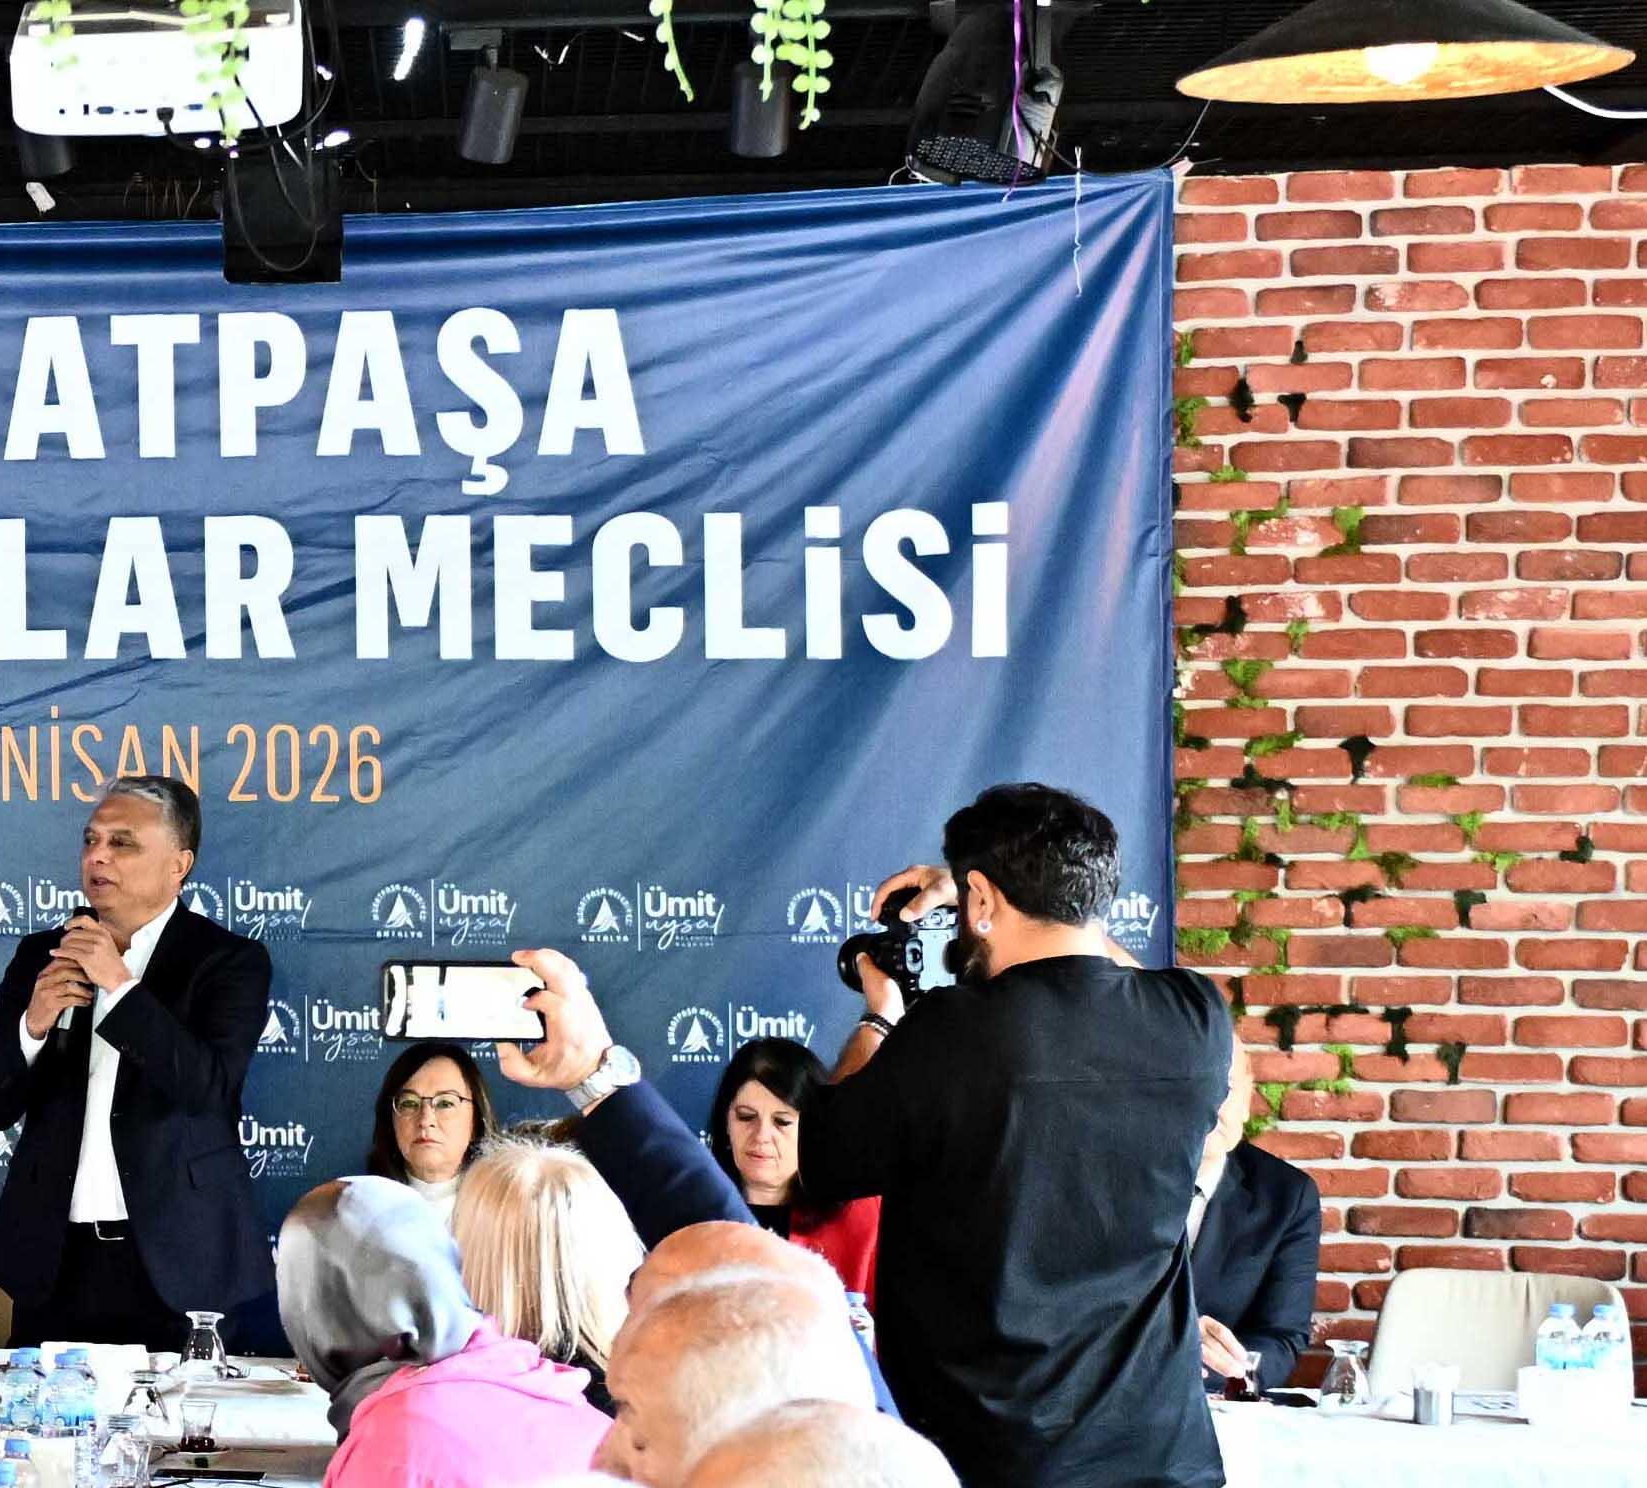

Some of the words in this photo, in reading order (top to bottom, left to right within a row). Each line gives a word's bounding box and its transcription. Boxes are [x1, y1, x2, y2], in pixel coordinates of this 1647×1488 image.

[1, 705, 200, 801] NİSAN
[226, 723, 383, 803] 2026
[234, 880, 304, 911] Ümit
[438, 883, 508, 914] Ümit
[644, 885, 716, 917] Ümit
[312, 999, 380, 1030] Ümit
[736, 1005, 807, 1038] Ümit
[238, 1115, 306, 1147] Ümit
